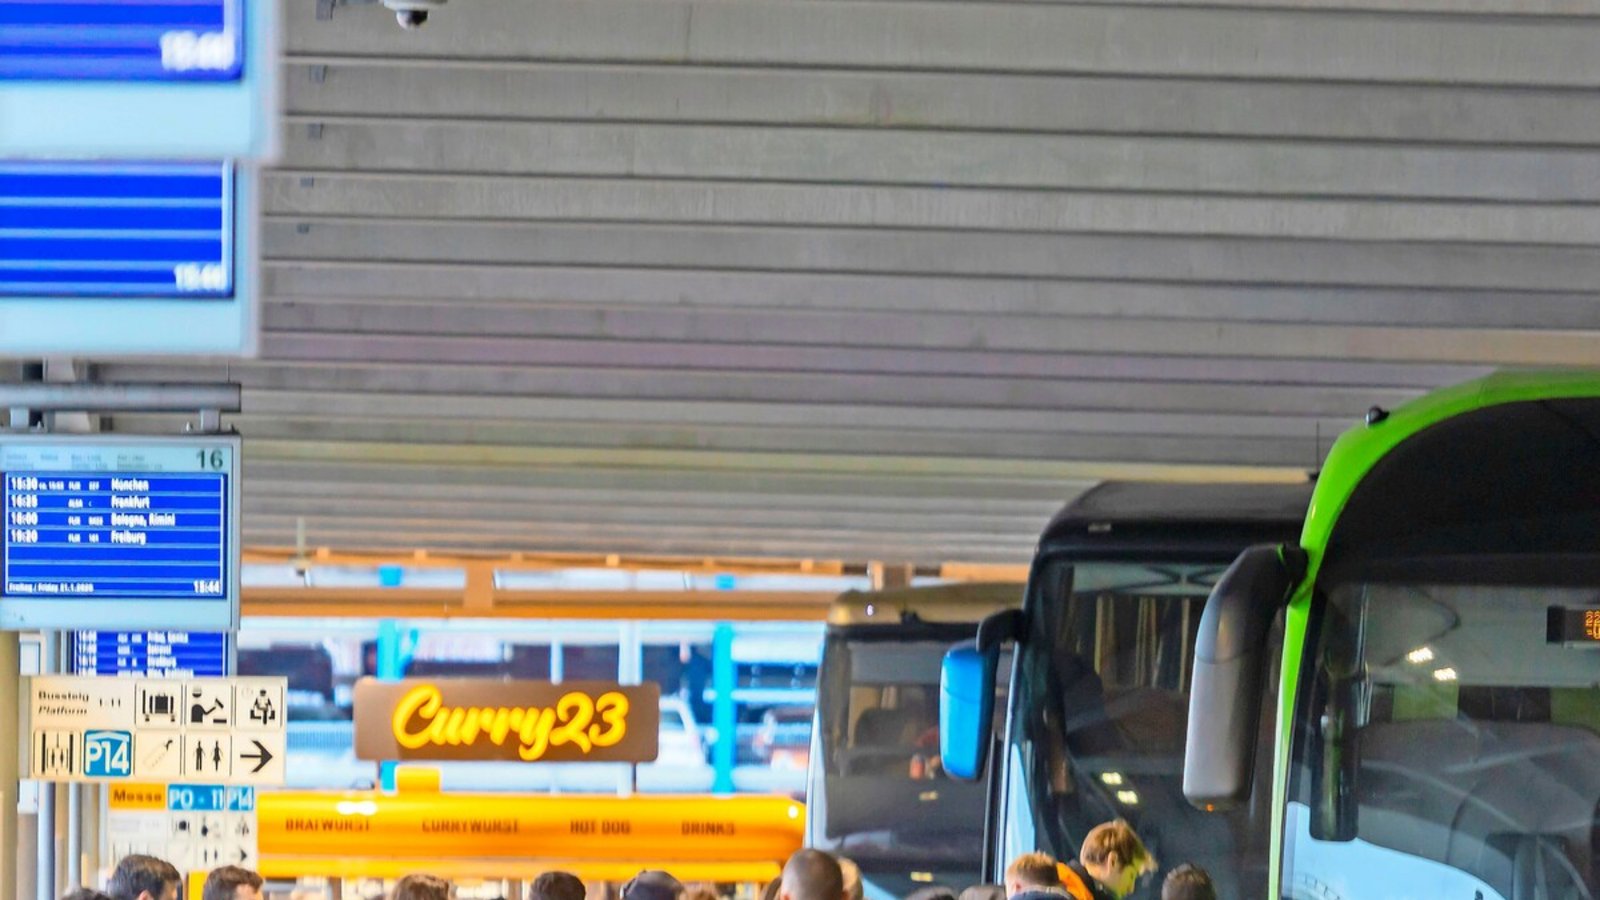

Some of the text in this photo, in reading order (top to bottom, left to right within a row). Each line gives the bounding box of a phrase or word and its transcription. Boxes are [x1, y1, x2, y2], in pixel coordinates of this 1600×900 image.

[196, 449, 223, 471] 16
[111, 495, 150, 509] Frankfurt
[110, 512, 147, 528] Bologna,
[148, 512, 176, 526] Rimini
[110, 530, 146, 545] Freiburg
[38, 690, 89, 702] Bussteig
[38, 705, 88, 715] Platform
[392, 684, 629, 760] Curry23
[86, 741, 128, 775] P14
[113, 789, 162, 802] Messe
[226, 786, 252, 811] P14
[285, 818, 370, 832] BRATWURST
[422, 818, 519, 834] CURRYWURST
[570, 819, 631, 836] HOT DOG
[681, 821, 735, 836] DRINKS
